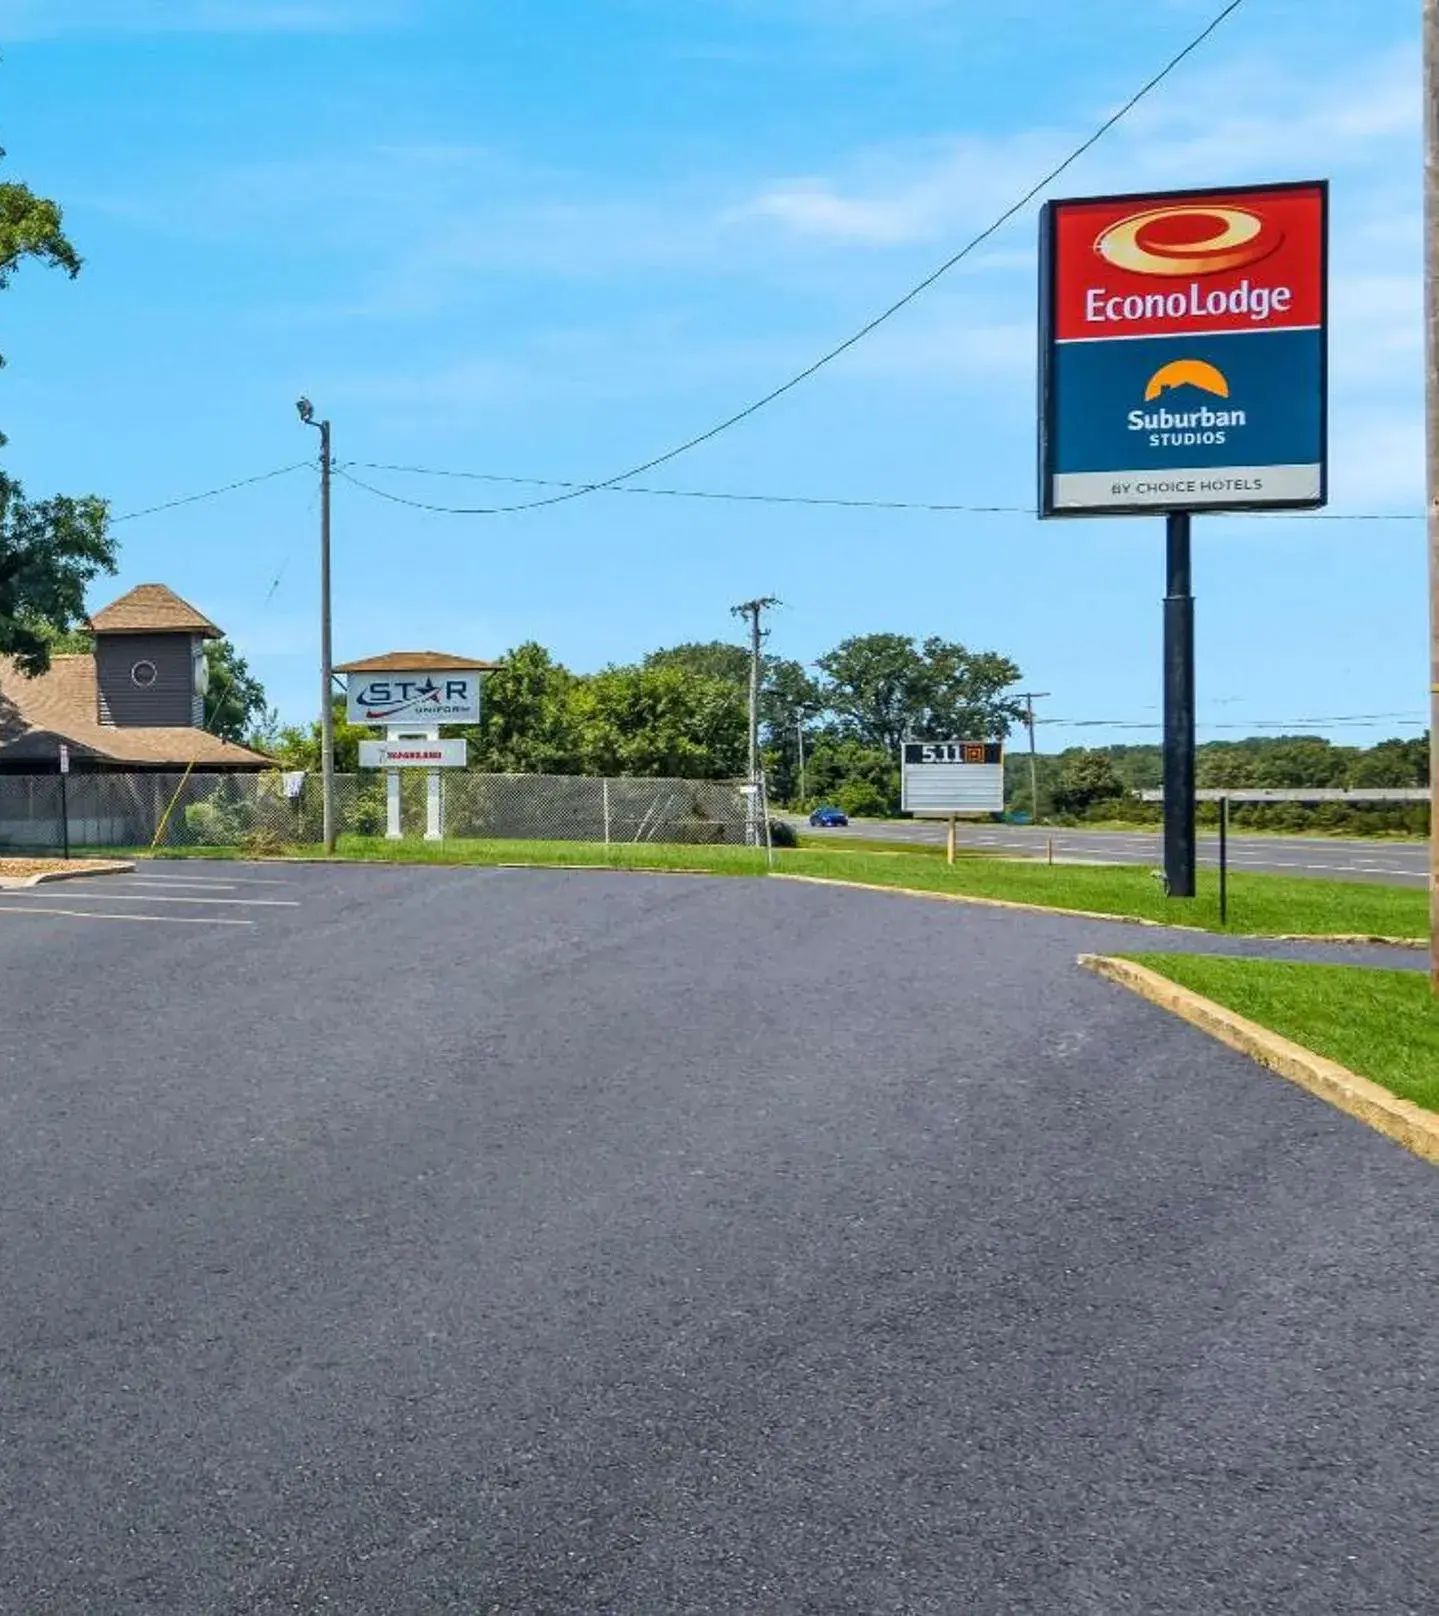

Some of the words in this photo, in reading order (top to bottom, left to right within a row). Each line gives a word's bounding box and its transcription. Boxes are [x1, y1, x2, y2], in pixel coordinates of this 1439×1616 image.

[1085, 280, 1291, 321] EconoLodge
[1127, 406, 1246, 431] Suburban
[1149, 431, 1226, 447] STUDIOS
[1111, 484, 1131, 495] BY
[1136, 481, 1196, 494] CHOICE
[1200, 479, 1263, 492] HOTELS
[415, 705, 471, 714] UNIFORM
